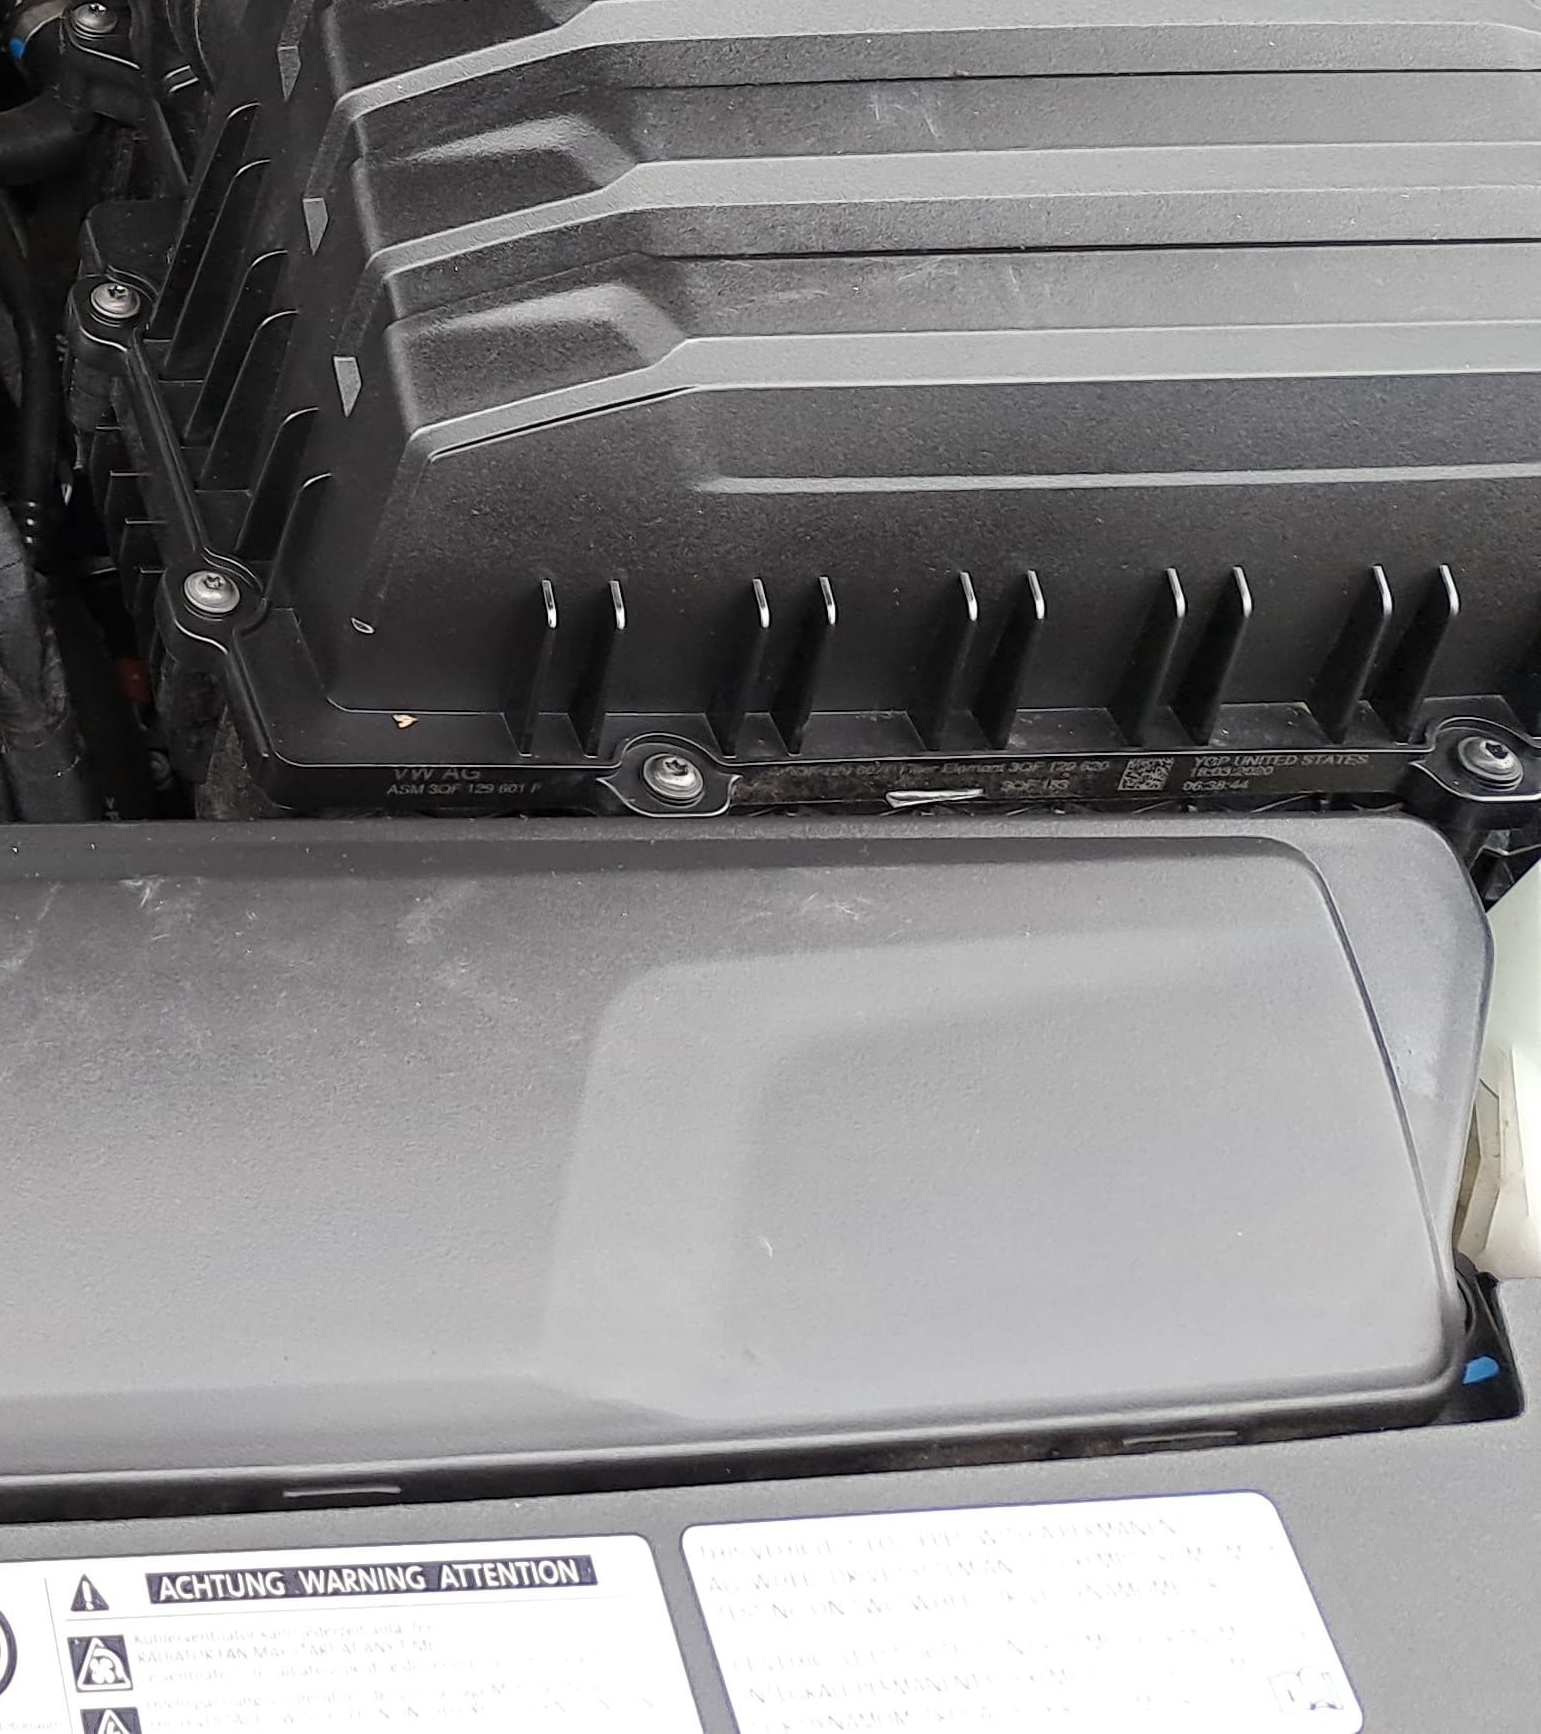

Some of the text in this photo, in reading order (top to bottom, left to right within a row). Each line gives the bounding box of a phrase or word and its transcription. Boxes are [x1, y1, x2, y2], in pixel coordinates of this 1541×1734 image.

[1234, 755, 1298, 766] UNITED
[1301, 754, 1369, 765] STATES
[392, 768, 481, 780] VW AG
[386, 783, 424, 795] ASM
[160, 1559, 579, 1600] ACHTUNG WARNING ATTENTION
